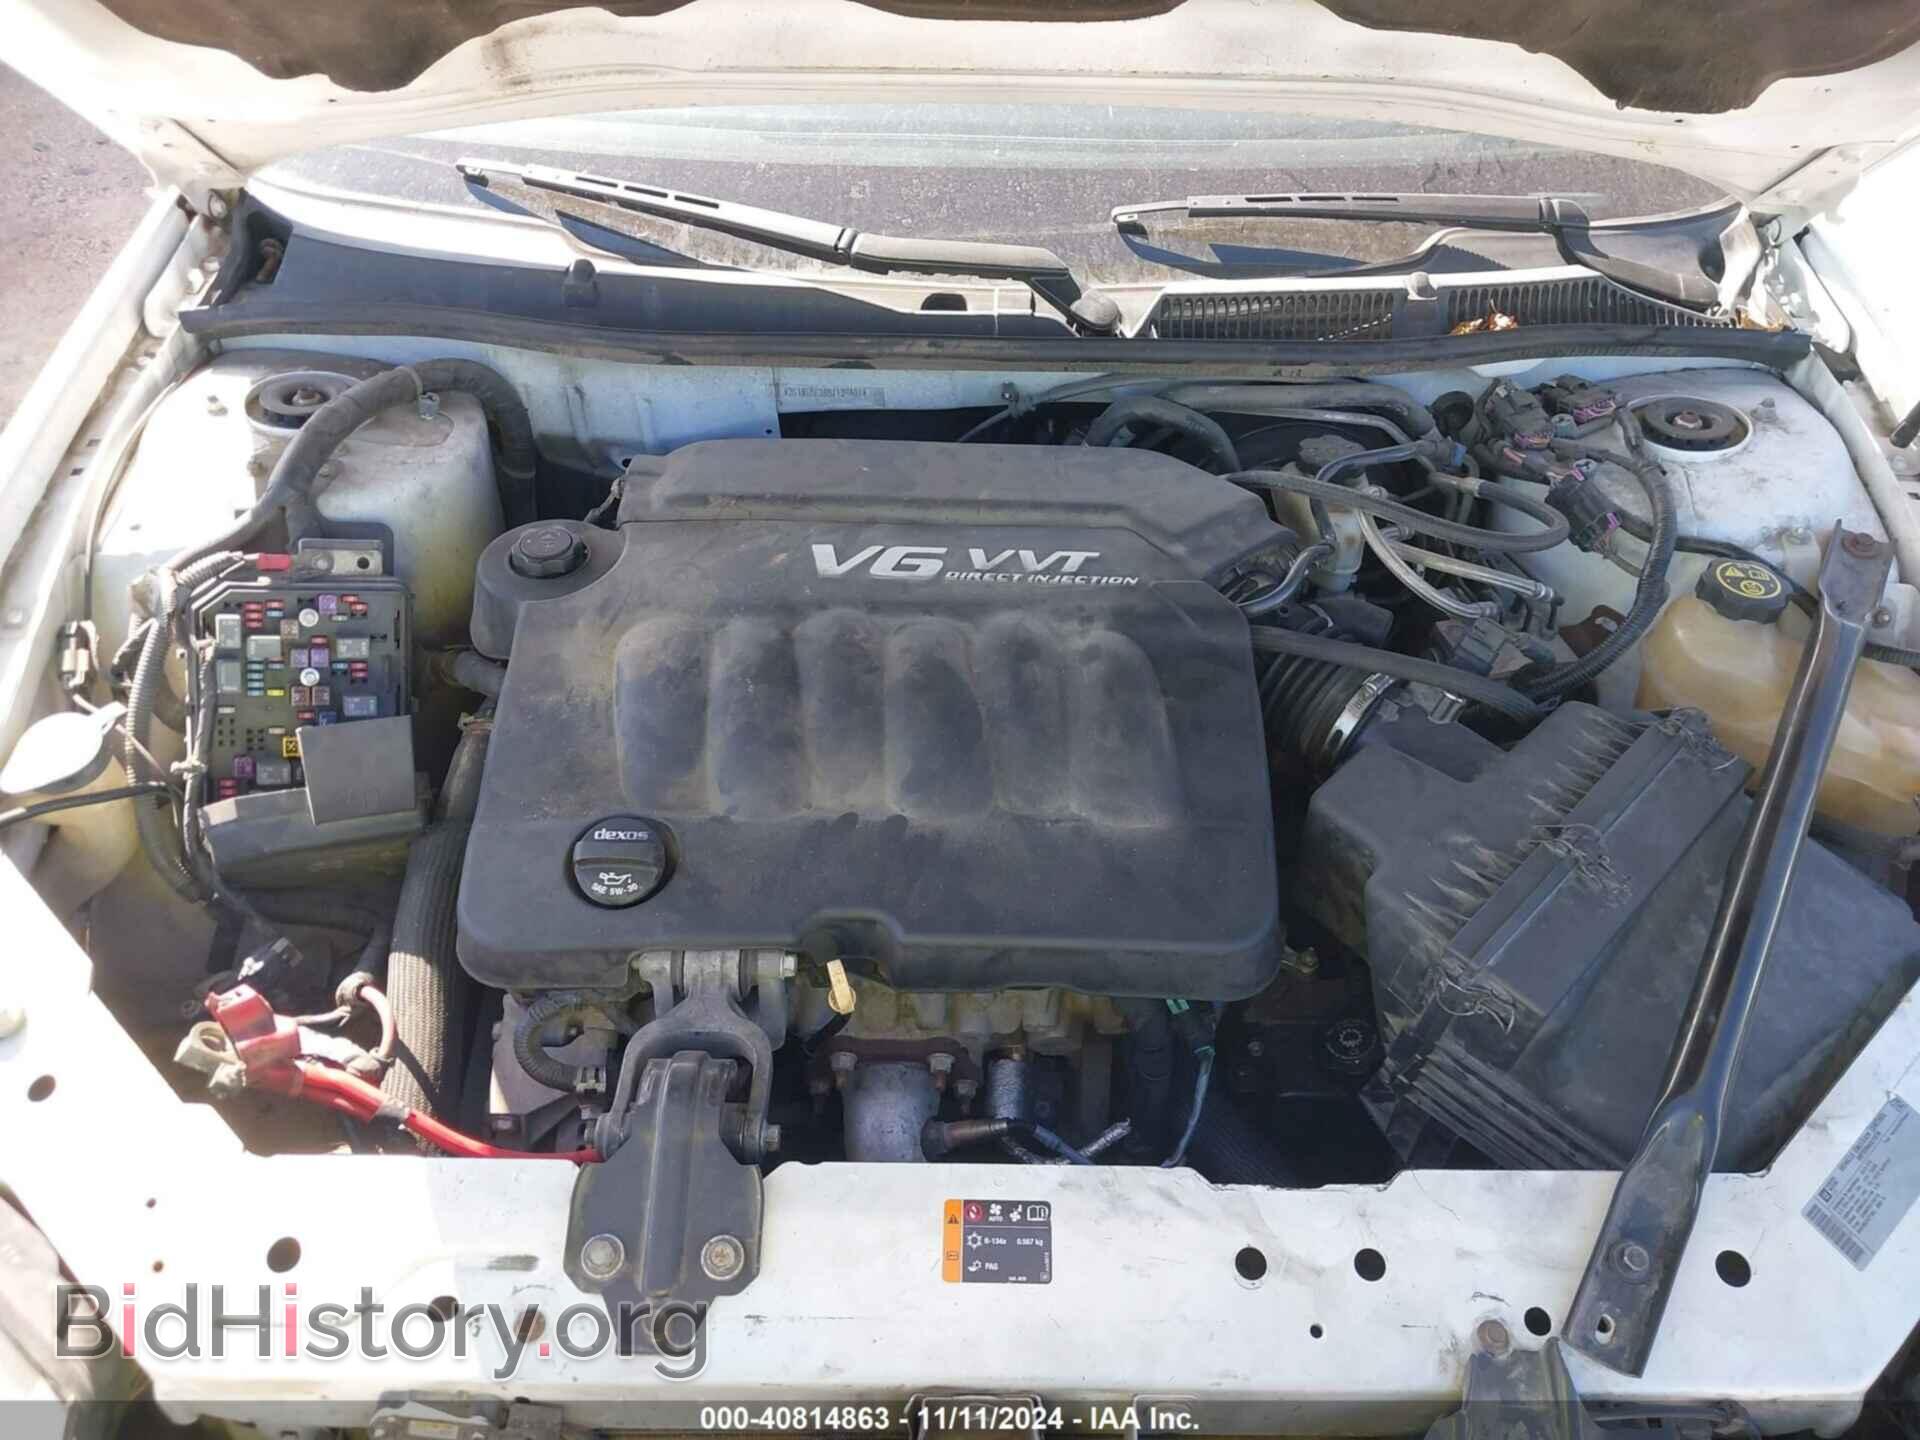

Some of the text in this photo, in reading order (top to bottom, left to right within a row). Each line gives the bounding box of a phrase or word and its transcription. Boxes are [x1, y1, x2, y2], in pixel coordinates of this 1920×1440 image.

[811, 544, 1100, 580] V6 VVT
[946, 571, 1139, 585] DIRECT INJECTION
[594, 828, 648, 840] dexos
[592, 883, 607, 894] SAE
